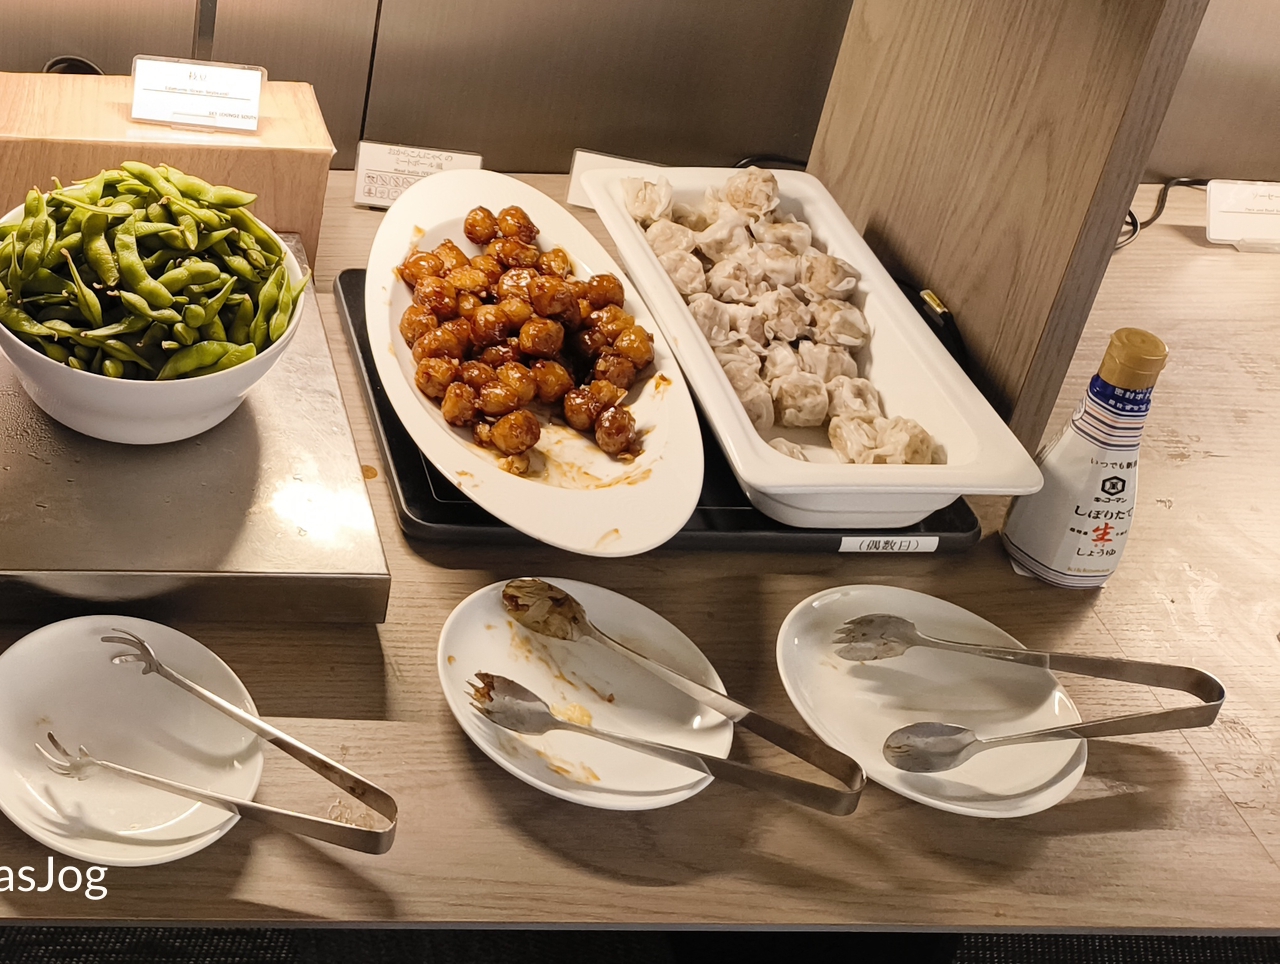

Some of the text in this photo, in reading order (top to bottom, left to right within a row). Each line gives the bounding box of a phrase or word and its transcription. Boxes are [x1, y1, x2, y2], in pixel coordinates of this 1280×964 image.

[1075, 505, 1133, 520] しぼりたて
[1091, 522, 1115, 542] 生
[1076, 548, 1116, 557] しょうゆ
